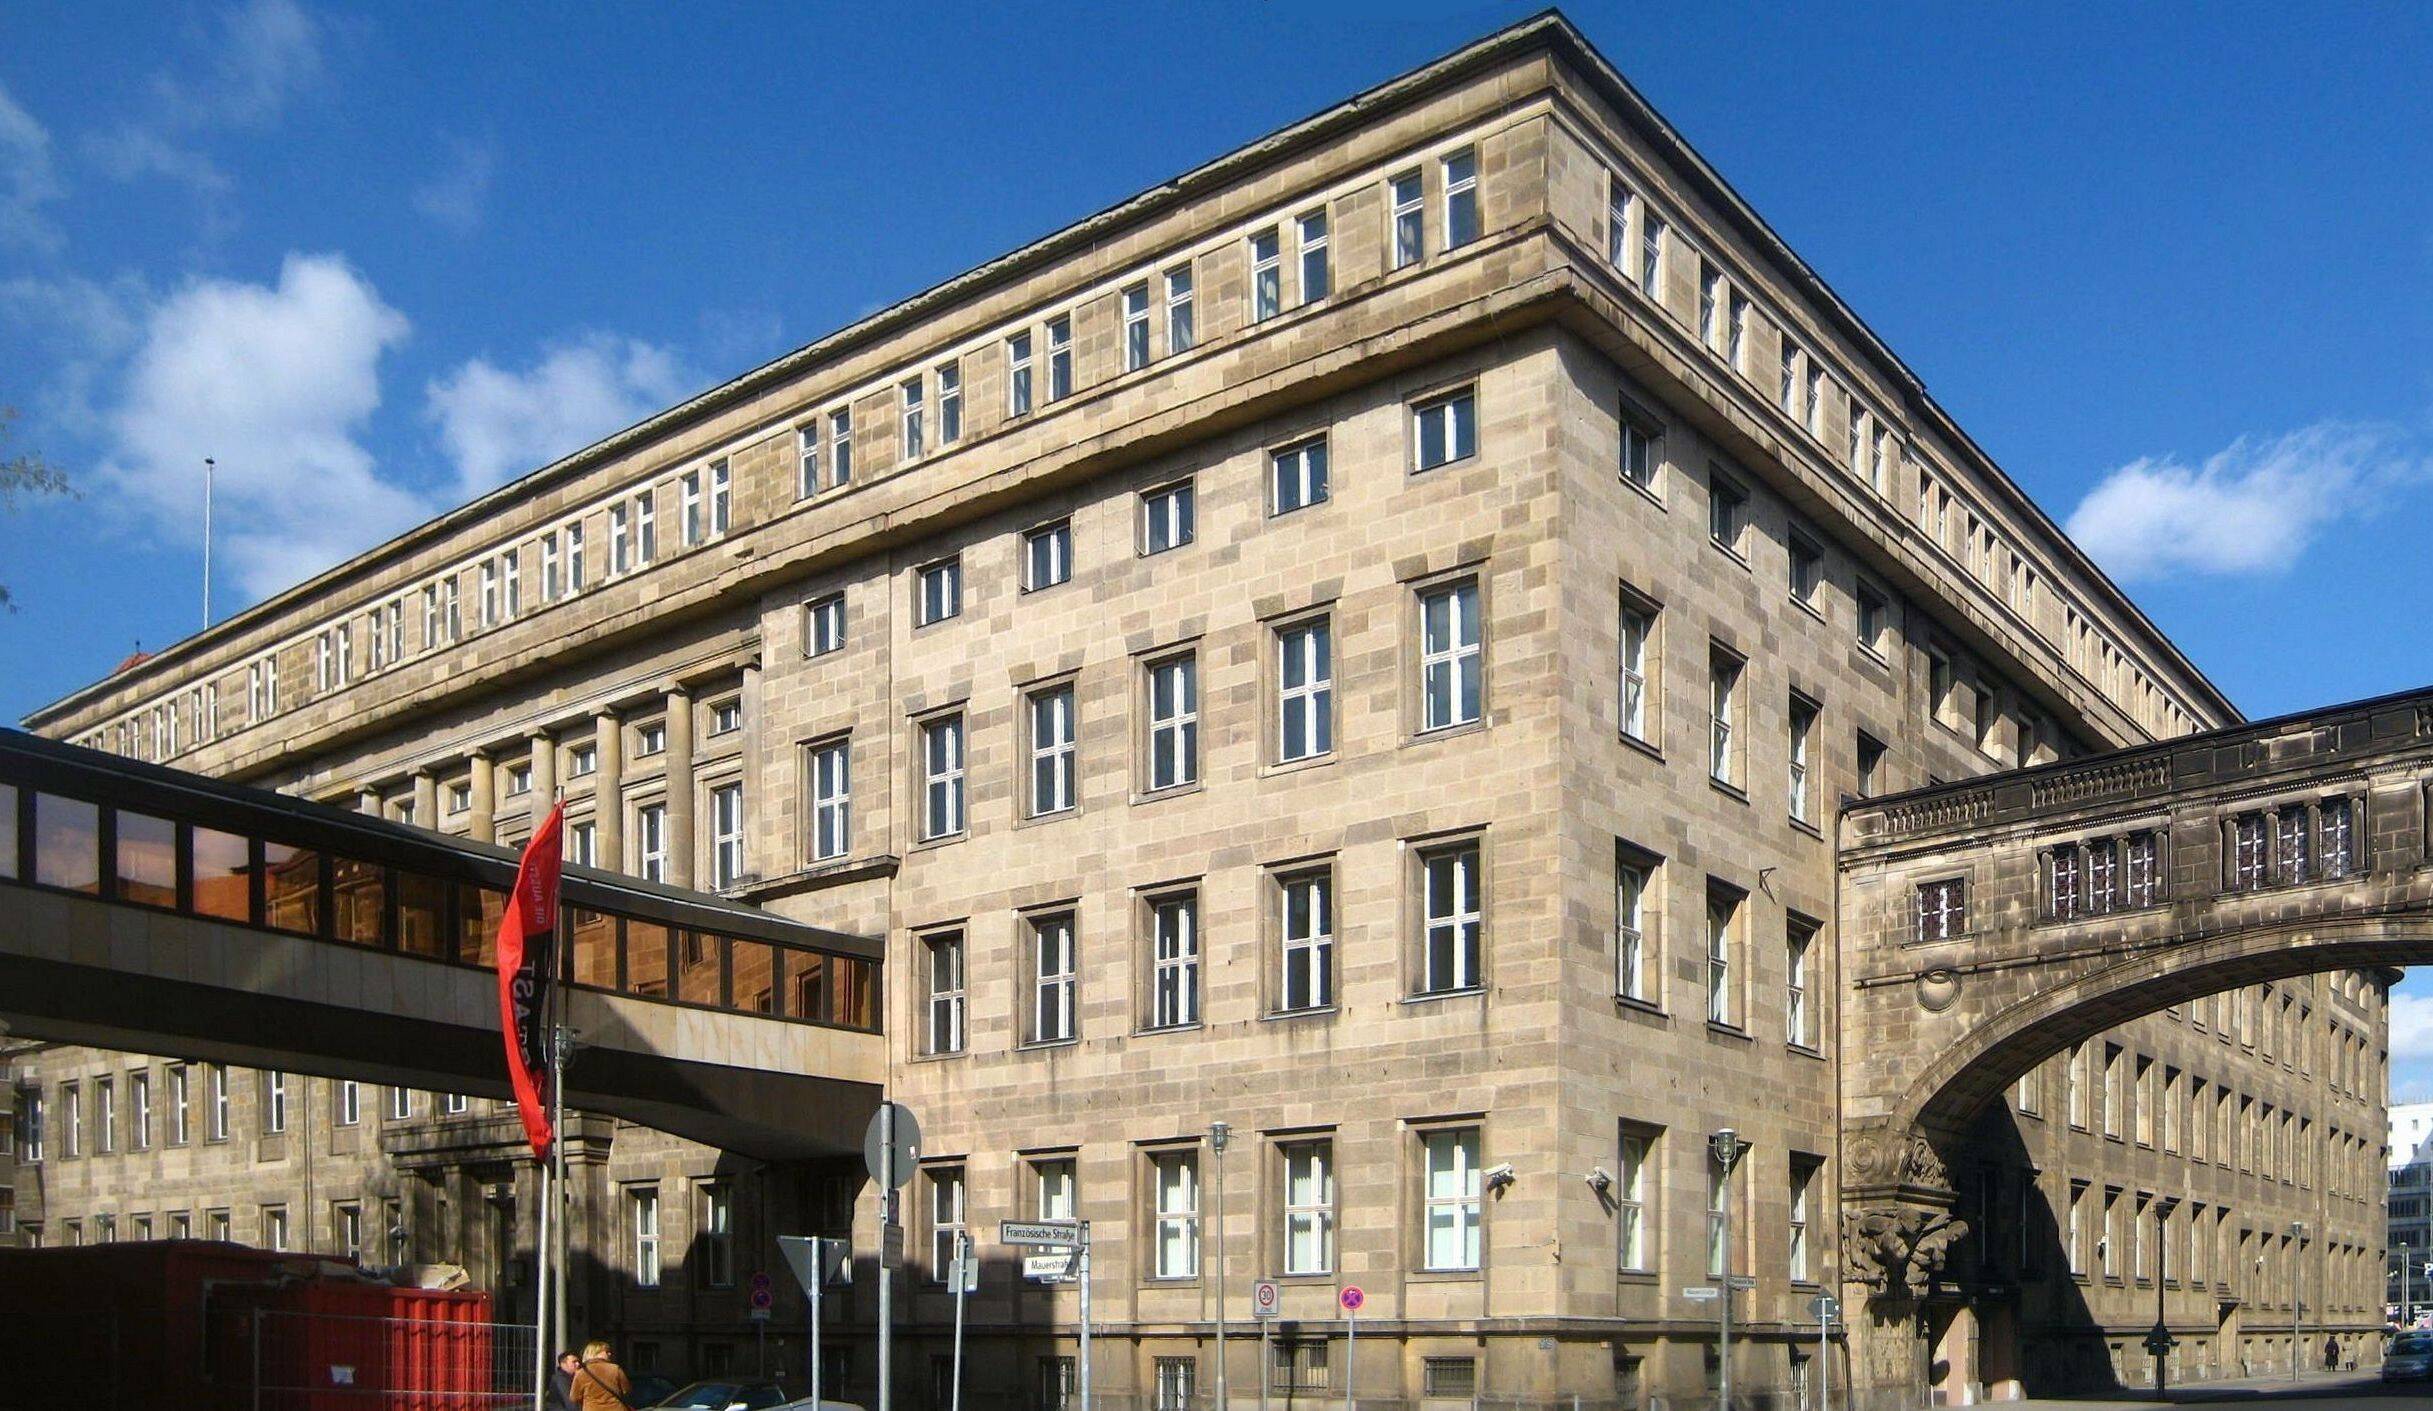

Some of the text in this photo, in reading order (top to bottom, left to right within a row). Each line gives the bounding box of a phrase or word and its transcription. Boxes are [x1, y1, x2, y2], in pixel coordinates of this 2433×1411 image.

[1006, 1226, 1075, 1242] Französische Straße
[1261, 1290, 1272, 1300] 30
